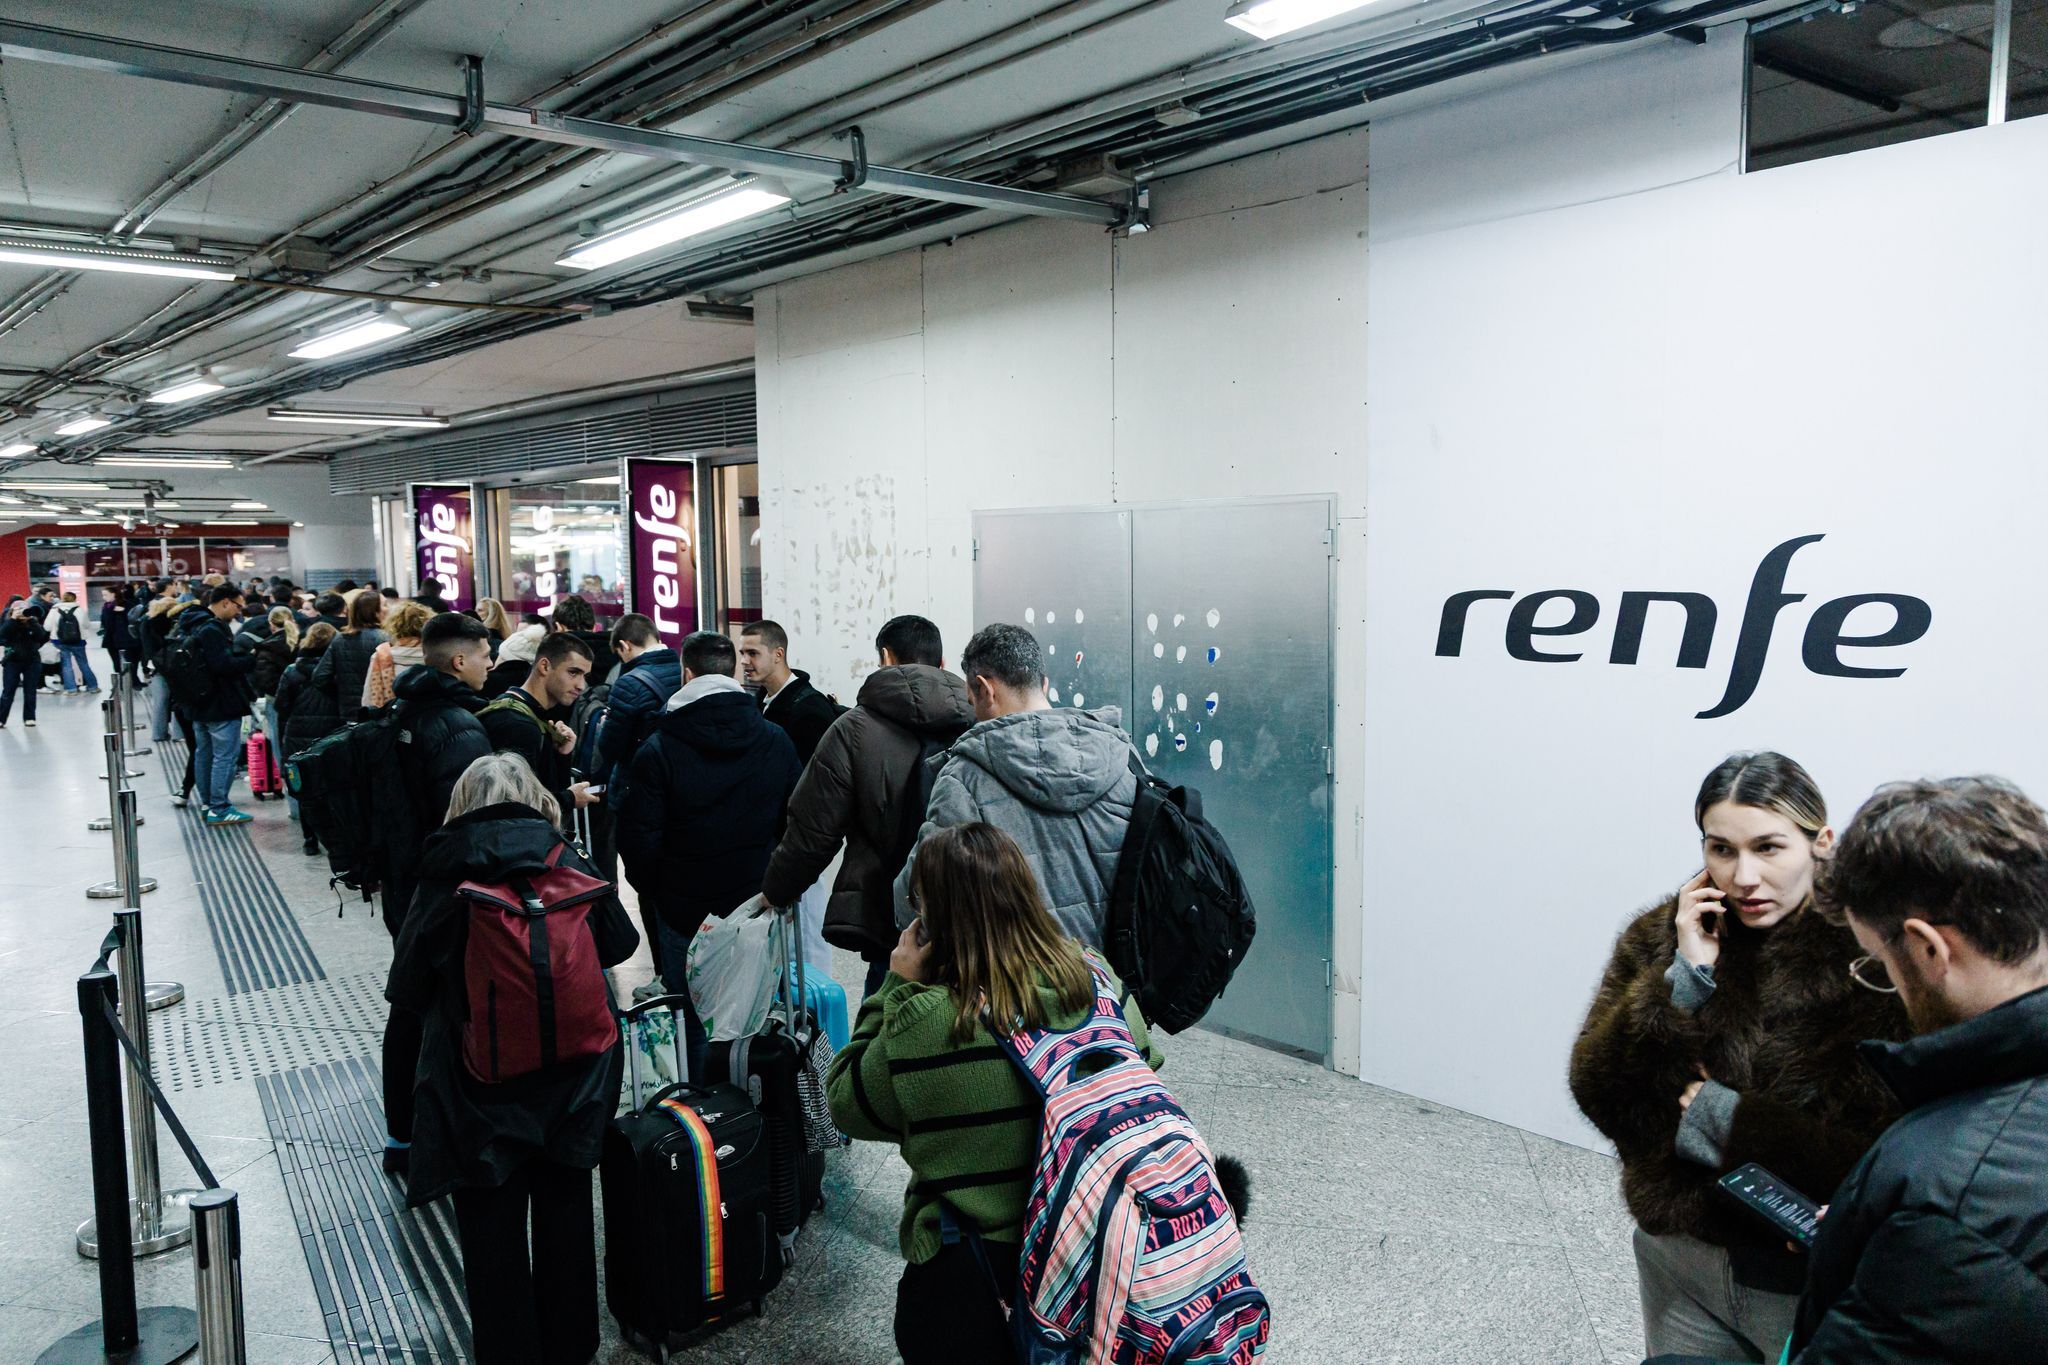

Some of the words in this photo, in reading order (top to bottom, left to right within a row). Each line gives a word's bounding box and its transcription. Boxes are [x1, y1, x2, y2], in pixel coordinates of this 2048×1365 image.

[419, 503, 471, 613] enfe
[634, 484, 692, 634] renfe
[1435, 533, 1932, 720] renfe
[1168, 1206, 1207, 1242] ROXY
